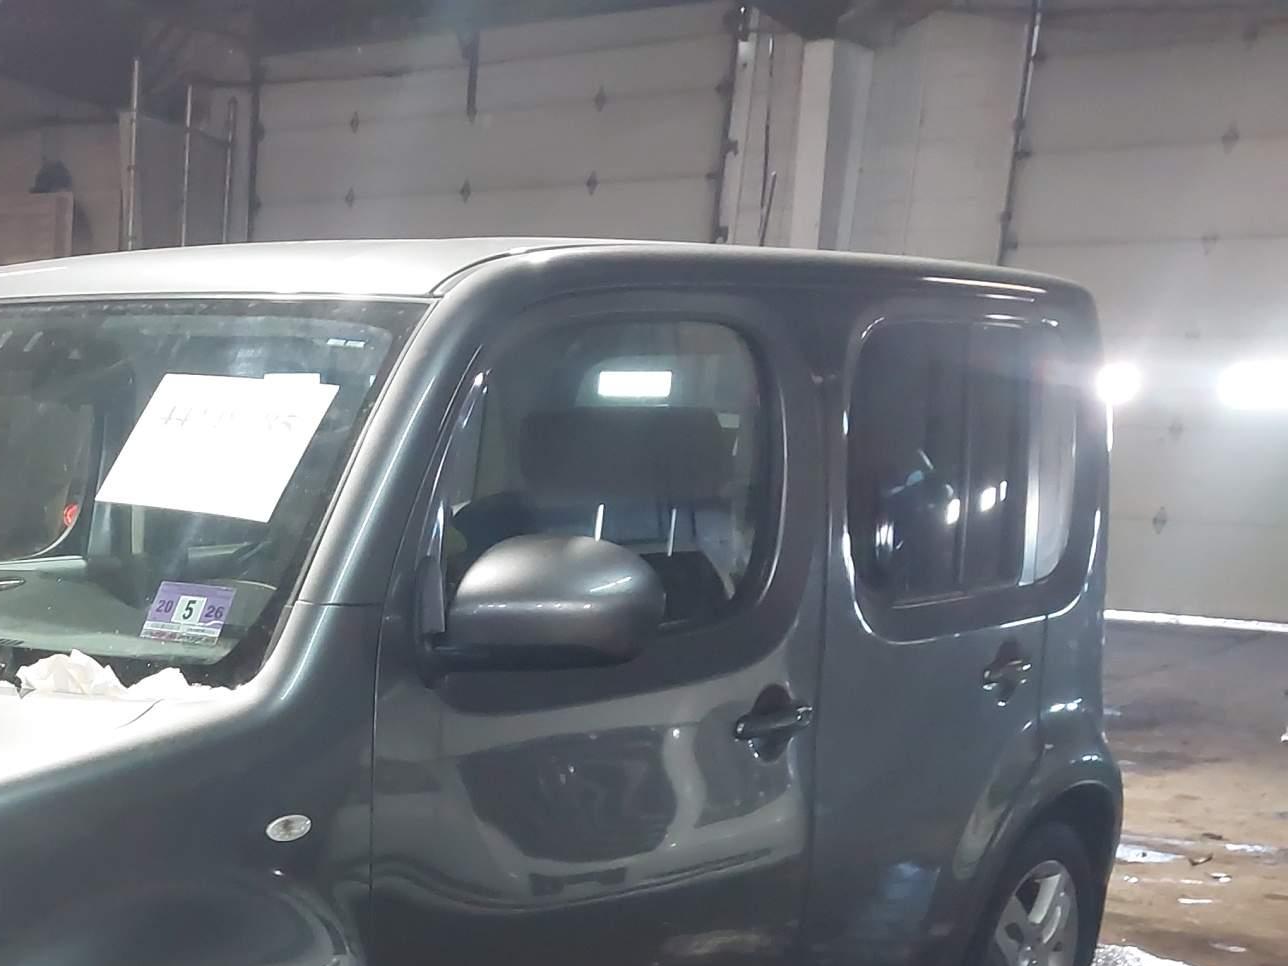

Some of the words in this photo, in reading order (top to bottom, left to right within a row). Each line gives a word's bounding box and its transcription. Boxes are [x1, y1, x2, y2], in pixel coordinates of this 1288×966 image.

[155, 599, 174, 613] 20
[182, 599, 197, 620] 5
[204, 605, 224, 619] 26
